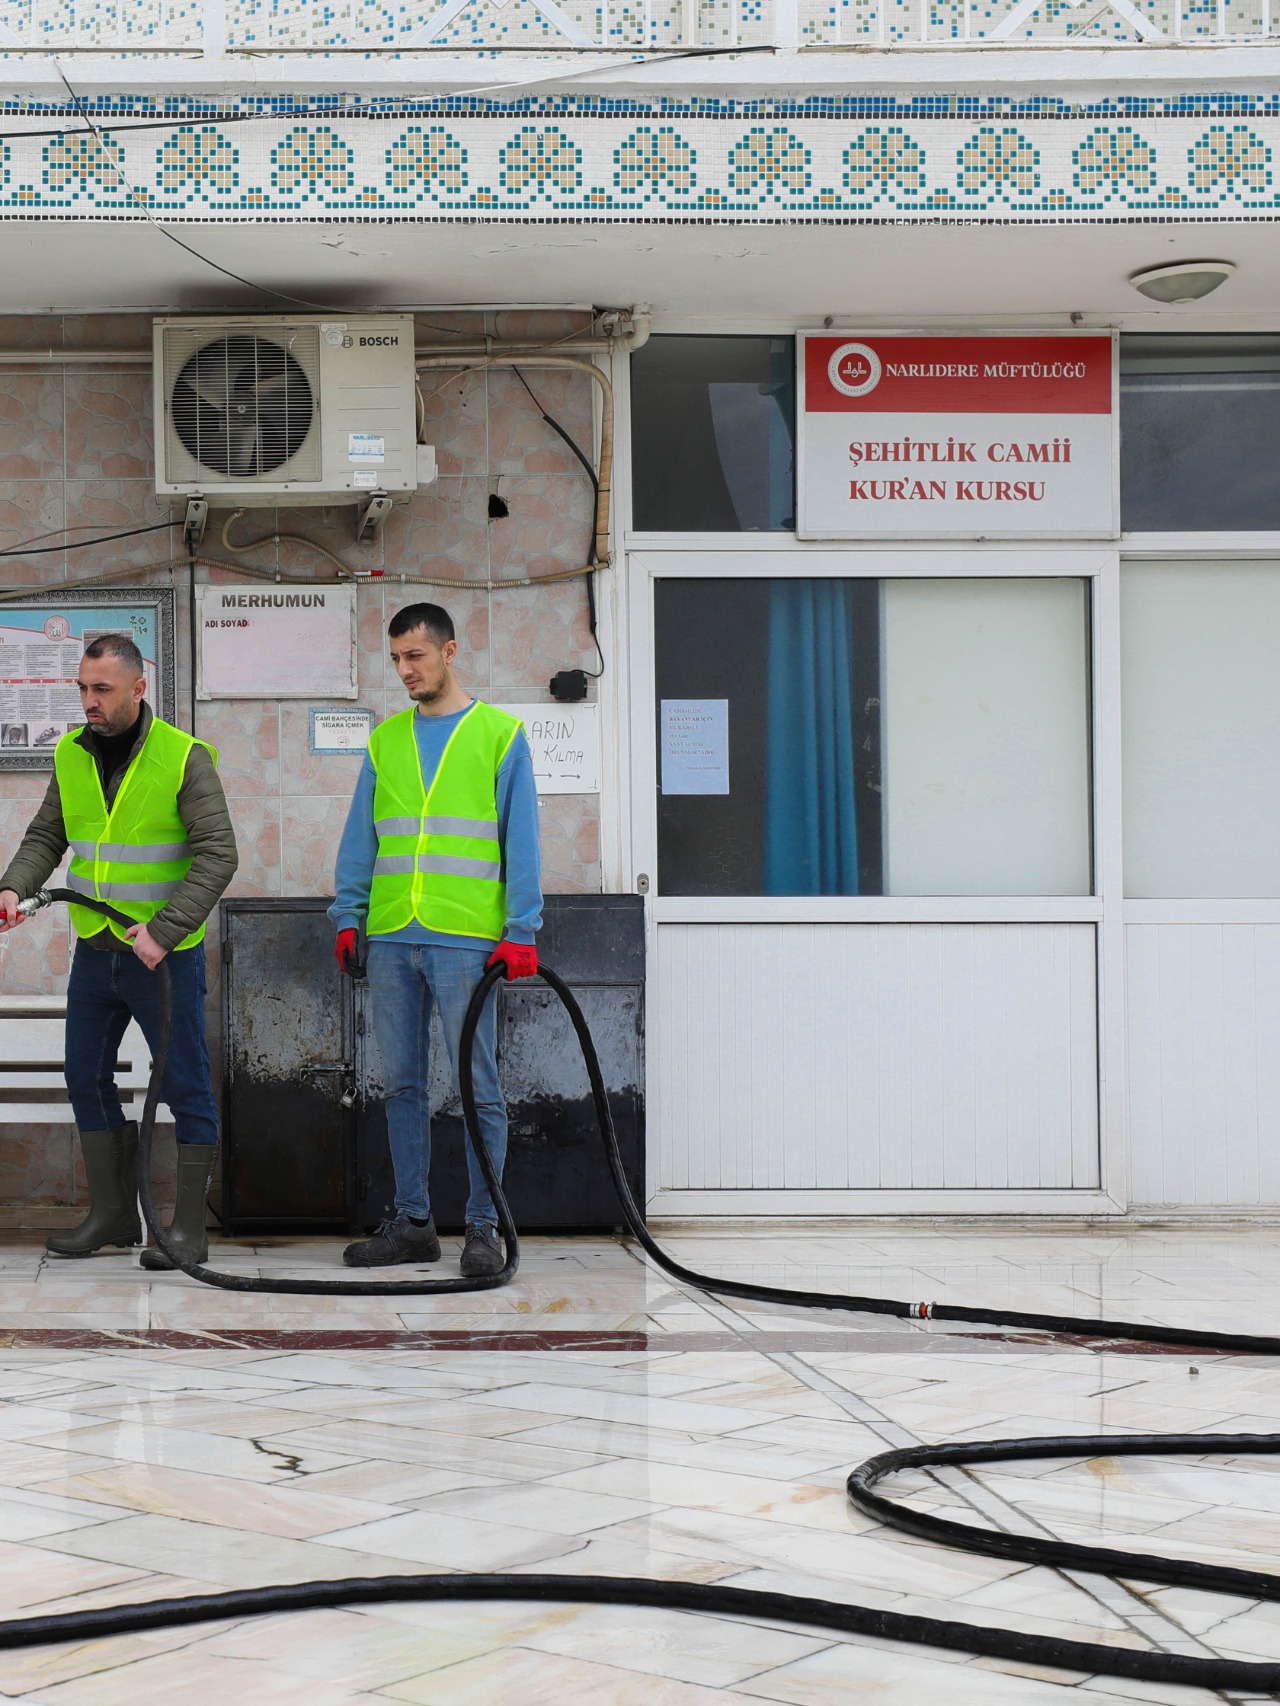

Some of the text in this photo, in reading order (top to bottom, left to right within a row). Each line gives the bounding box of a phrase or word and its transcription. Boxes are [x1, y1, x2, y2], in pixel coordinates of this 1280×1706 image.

[359, 336, 399, 347] BOSCH
[885, 362, 1086, 378] NARLIDERE MÜFTÜLÜĞÜ
[849, 436, 1072, 467] ŞEHİTLİK CAMİİ
[849, 477, 1046, 501] KUR'AN KURSU
[221, 594, 325, 608] MERHUMUN
[205, 620, 218, 628] ADI
[331, 715, 369, 723] BAHÇESİNDE
[526, 715, 575, 740] ARIN
